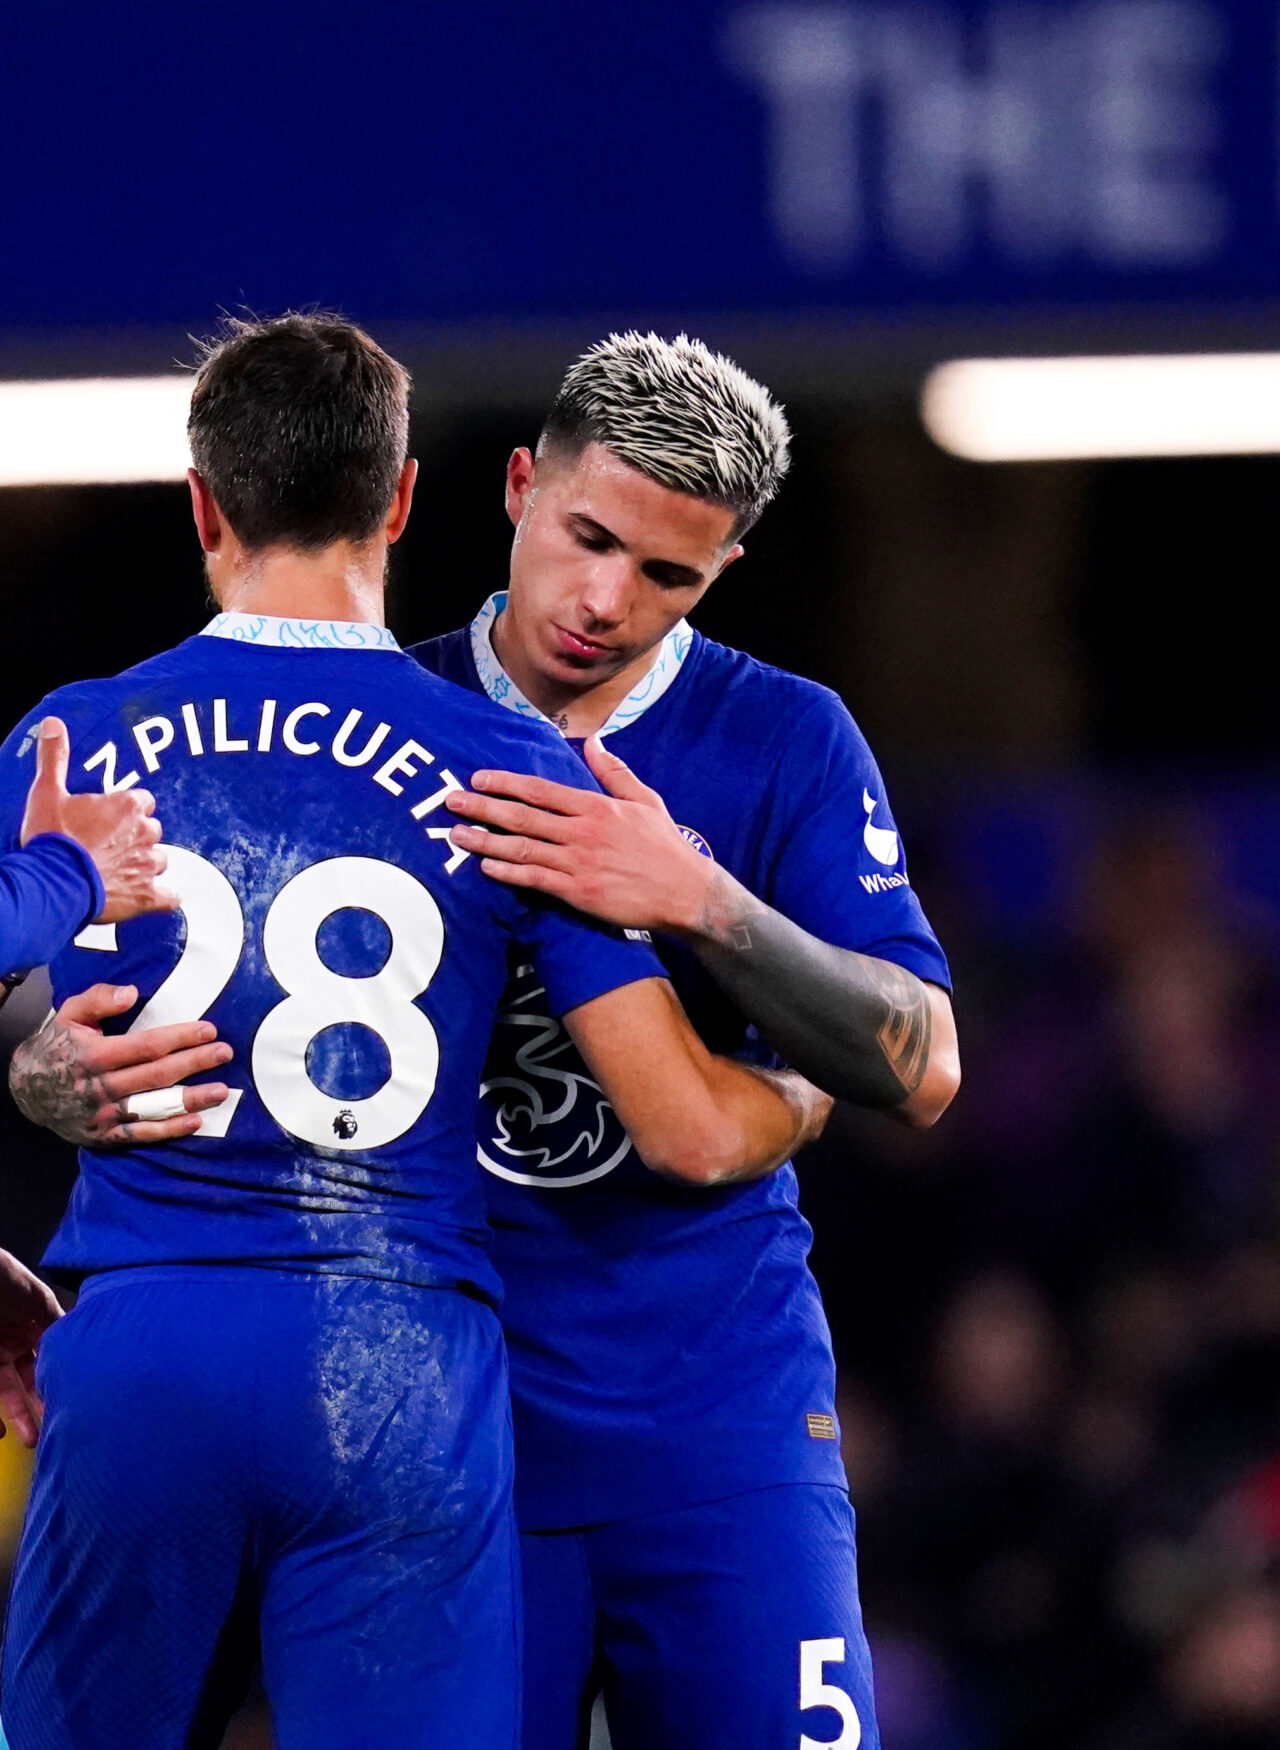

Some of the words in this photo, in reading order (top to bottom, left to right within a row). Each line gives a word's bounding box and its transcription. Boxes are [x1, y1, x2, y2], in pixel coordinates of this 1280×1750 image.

[725, 4, 1226, 266] THE
[82, 698, 490, 875] ZPILICUETA
[73, 842, 445, 1152] 28
[799, 1636, 862, 1750] 5
